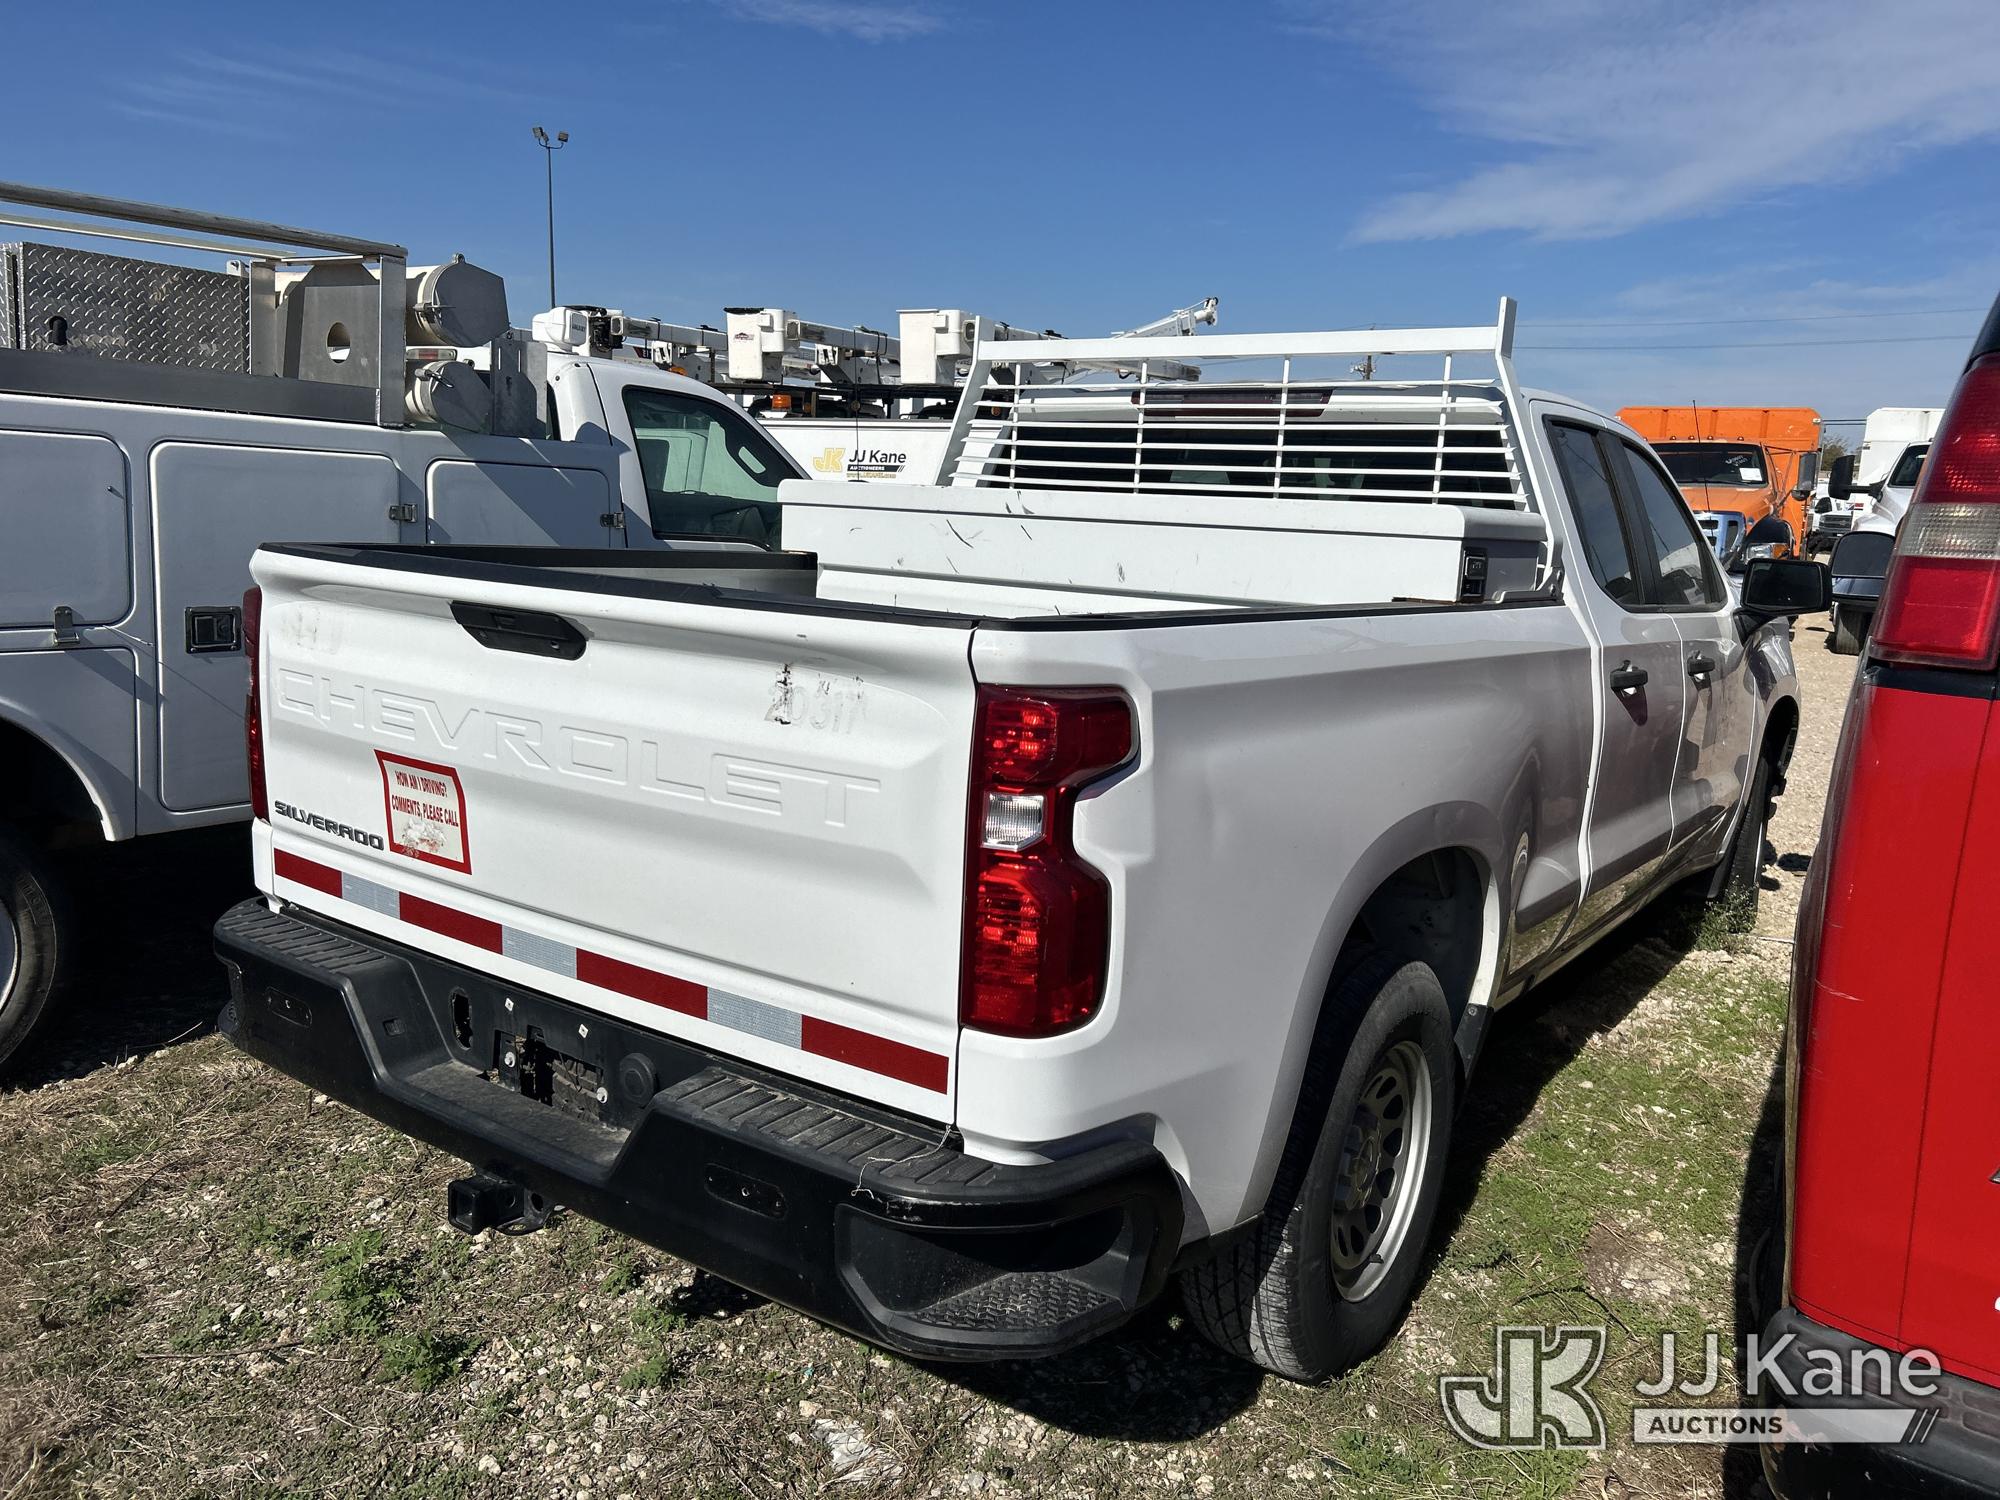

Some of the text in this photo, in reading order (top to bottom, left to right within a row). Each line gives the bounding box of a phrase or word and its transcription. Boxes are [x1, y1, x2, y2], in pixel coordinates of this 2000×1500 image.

[849, 450, 907, 463] JJ Kane
[278, 668, 882, 828] CHEVROLET
[395, 770, 410, 787] HOW
[408, 774, 419, 790] AM
[420, 777, 447, 797] DRIVING?
[275, 800, 384, 850] SILVERADO
[392, 795, 459, 827] COMMENTS, PLEASE CALL
